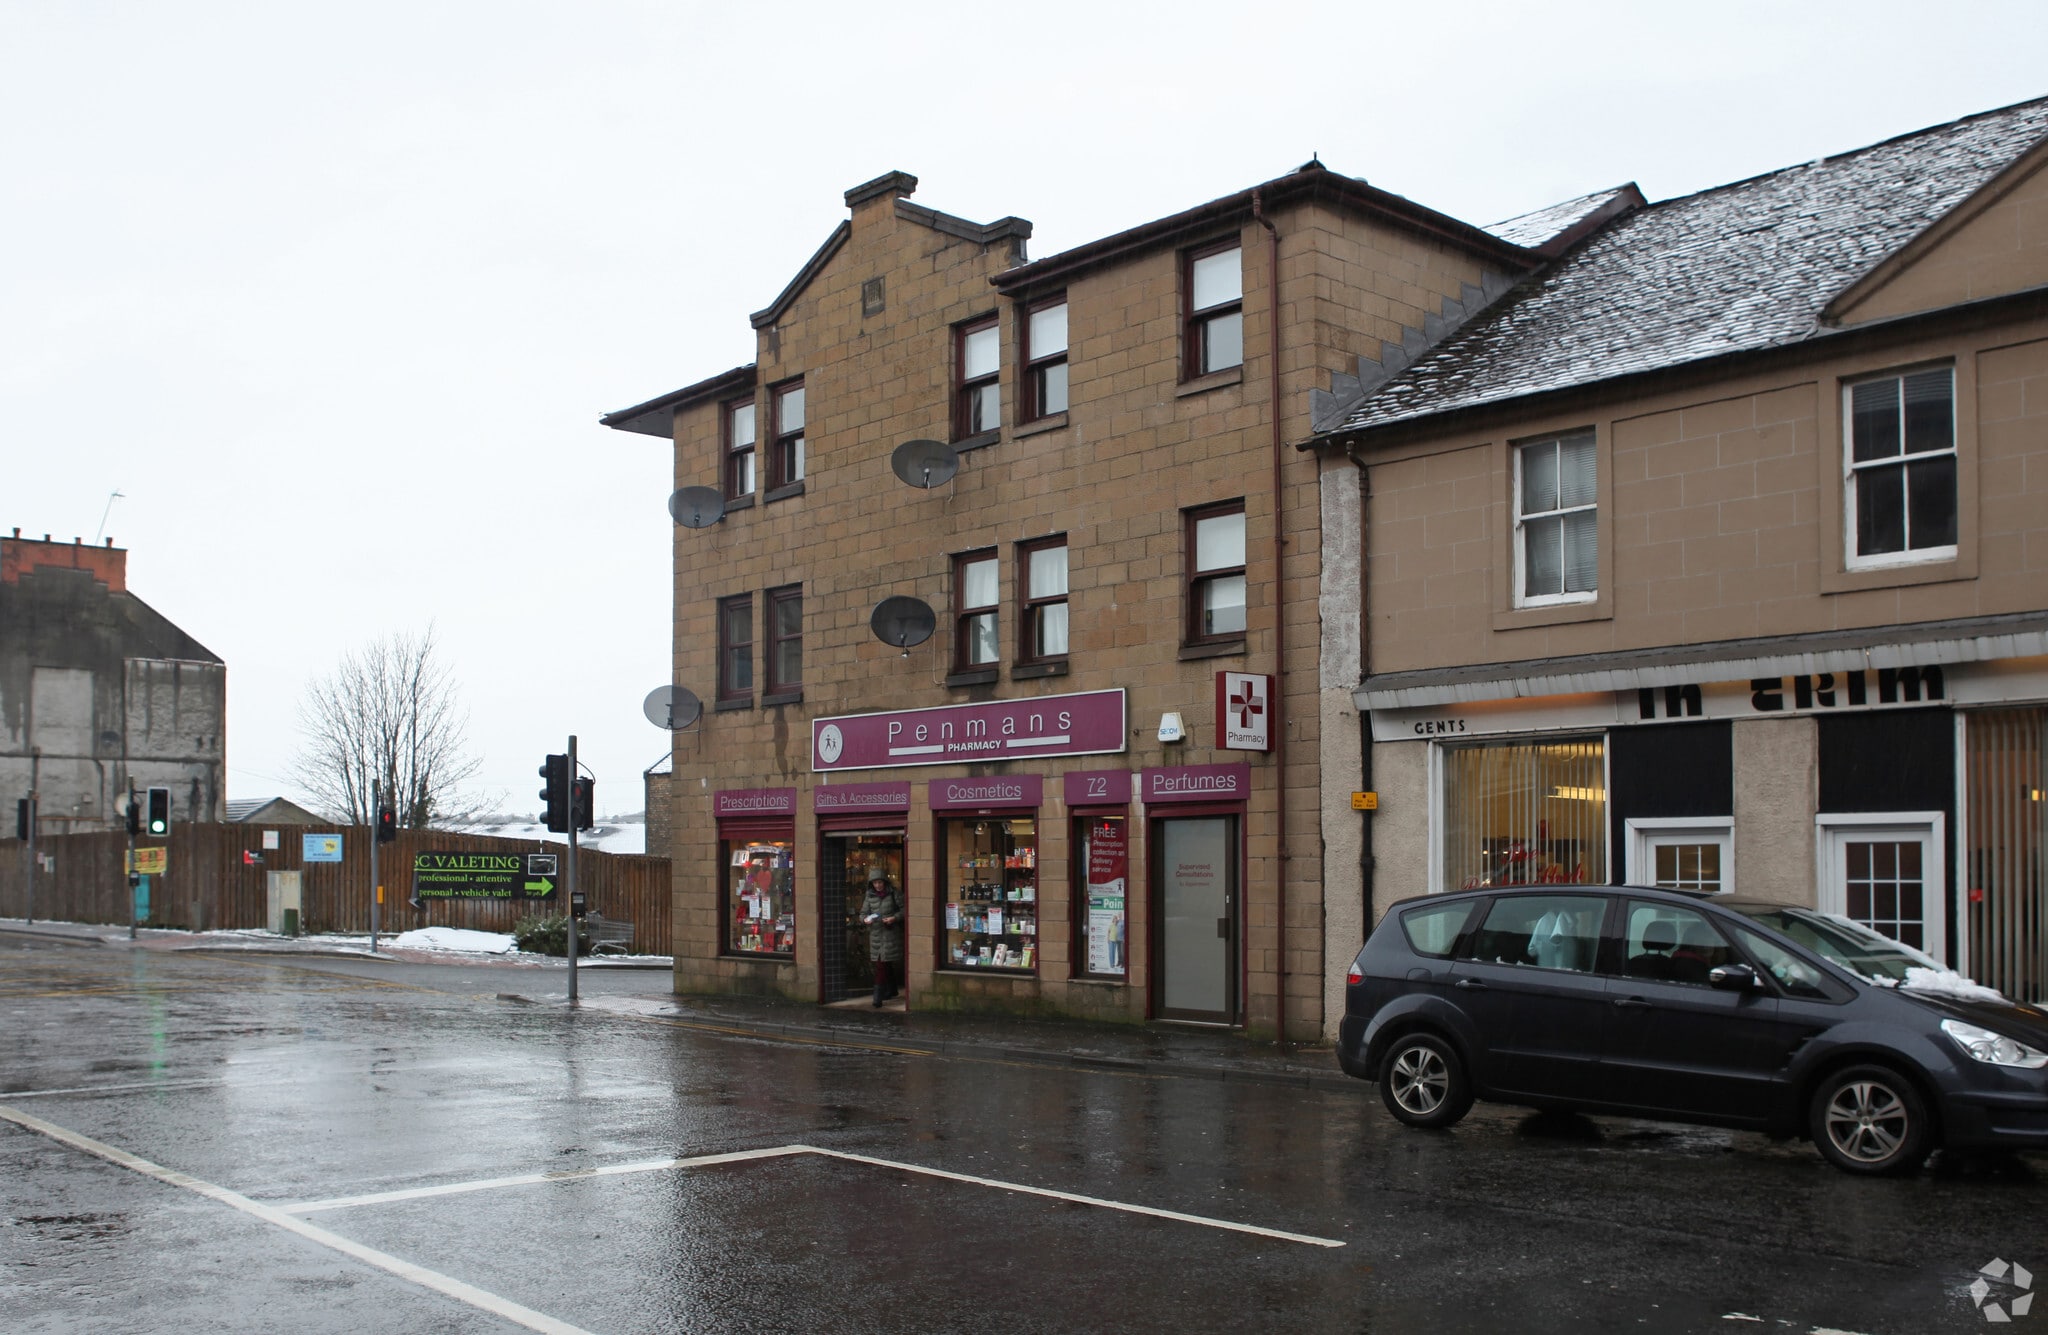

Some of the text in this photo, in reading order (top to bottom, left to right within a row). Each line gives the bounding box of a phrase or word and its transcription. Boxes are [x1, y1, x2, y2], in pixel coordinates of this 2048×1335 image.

[888, 711, 1072, 743] Penmans
[1414, 720, 1465, 734] GENTS
[1228, 731, 1265, 745] Pharmacy
[947, 739, 1001, 753] PHARMACY
[1087, 777, 1107, 794] 72
[1153, 774, 1237, 793] Perfumes
[947, 782, 1022, 800] Cosmetics
[720, 795, 789, 810] Prescriptions
[816, 793, 907, 805] Gifts & Accessories
[1093, 827, 1116, 838] FREE
[434, 855, 520, 869] VALETING
[418, 874, 512, 883] professional attentive
[418, 889, 453, 898] personal
[461, 889, 490, 897] vehicle
[1103, 898, 1123, 909] Pain
